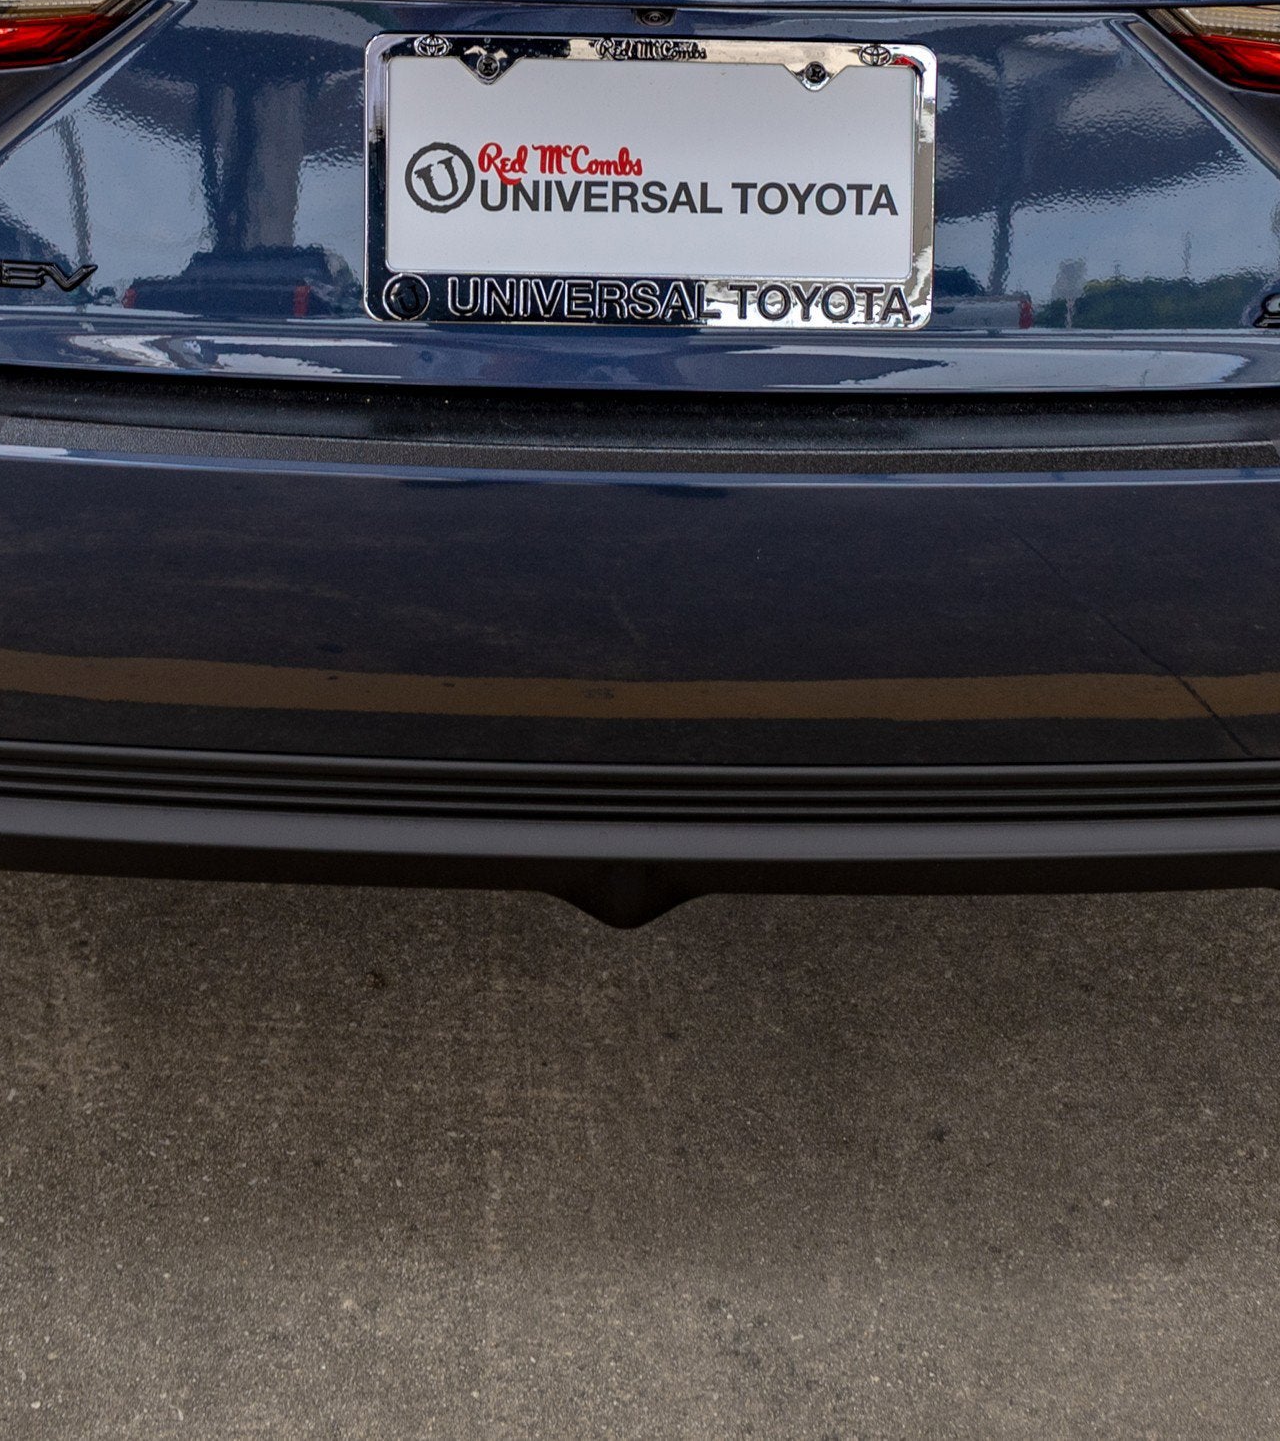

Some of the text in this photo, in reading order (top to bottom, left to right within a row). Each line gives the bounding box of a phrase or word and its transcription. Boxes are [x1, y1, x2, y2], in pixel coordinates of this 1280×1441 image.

[478, 141, 643, 186] Red McCombs
[479, 179, 723, 216] UNIVERSAL
[732, 181, 899, 217] TOYOTA
[447, 276, 721, 321] UNIVERSAL
[728, 283, 912, 323] TOYOTA
